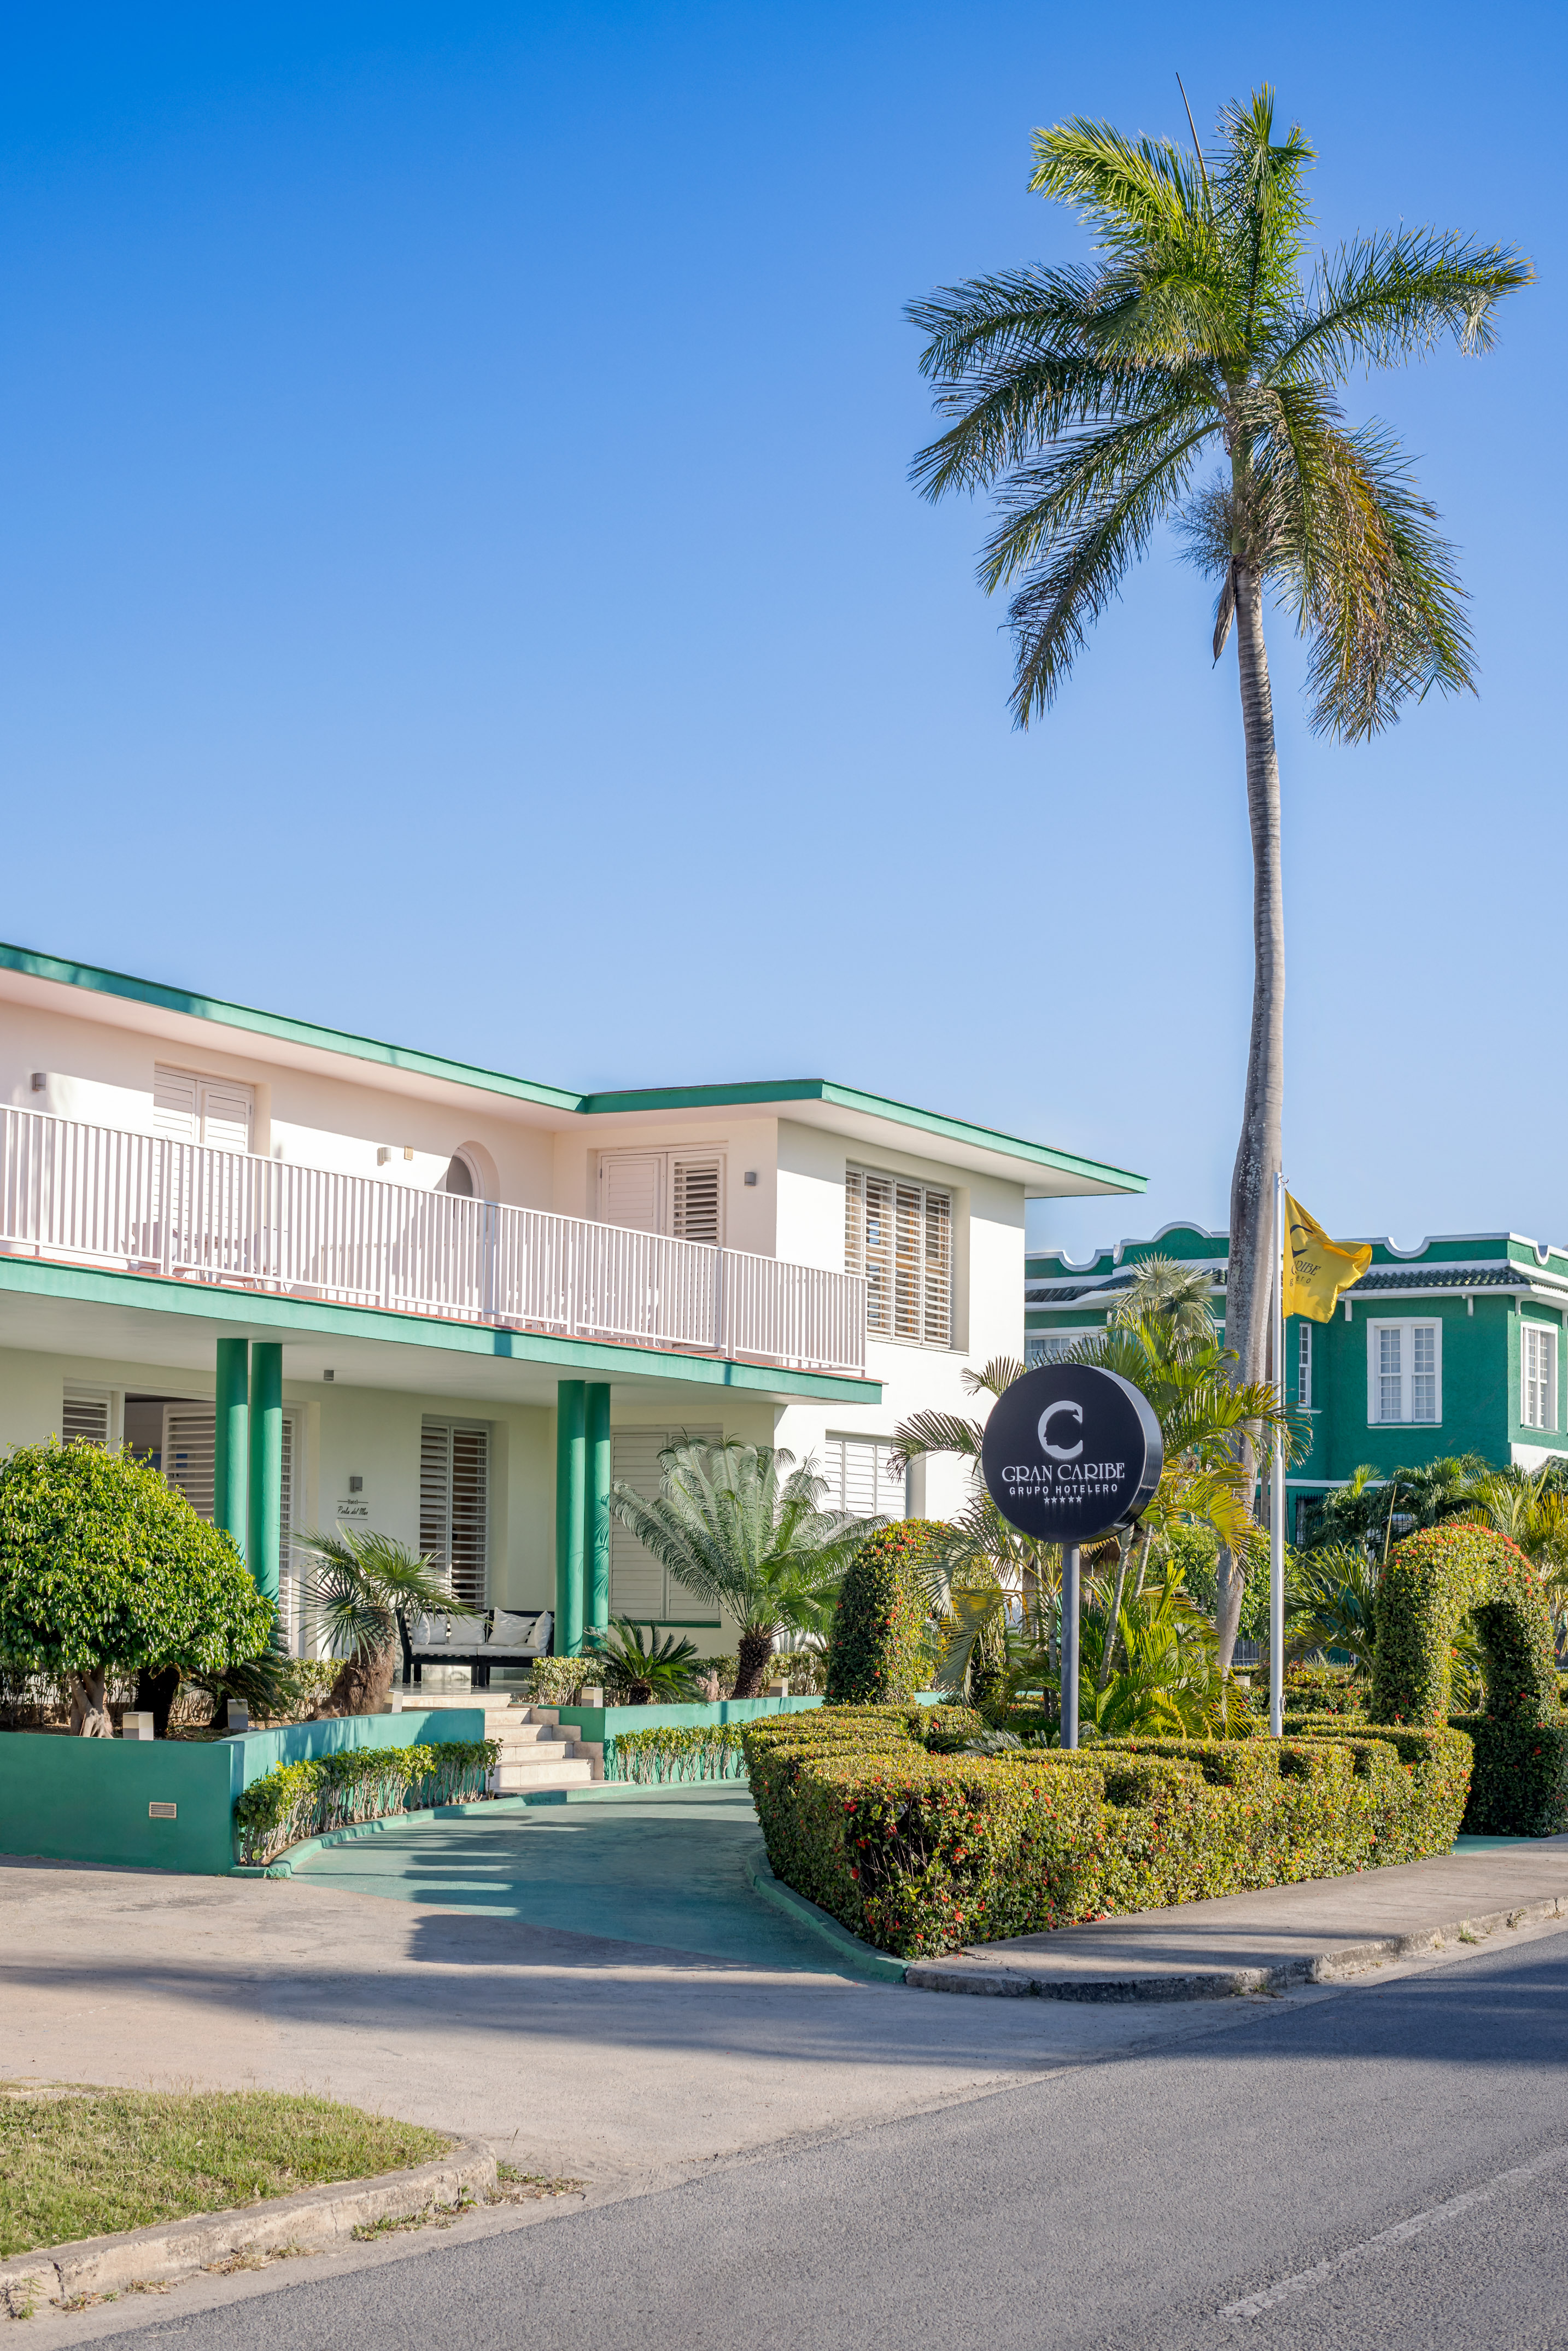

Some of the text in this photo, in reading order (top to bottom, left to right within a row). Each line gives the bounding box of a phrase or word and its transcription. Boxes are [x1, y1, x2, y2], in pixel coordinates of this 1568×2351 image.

[1295, 1260, 1321, 1276] RIBE
[1002, 1463, 1125, 1482] GRAN CARIBE
[1009, 1484, 1118, 1495] GRUPO HOTELERO
[337, 1506, 350, 1514] Perla
